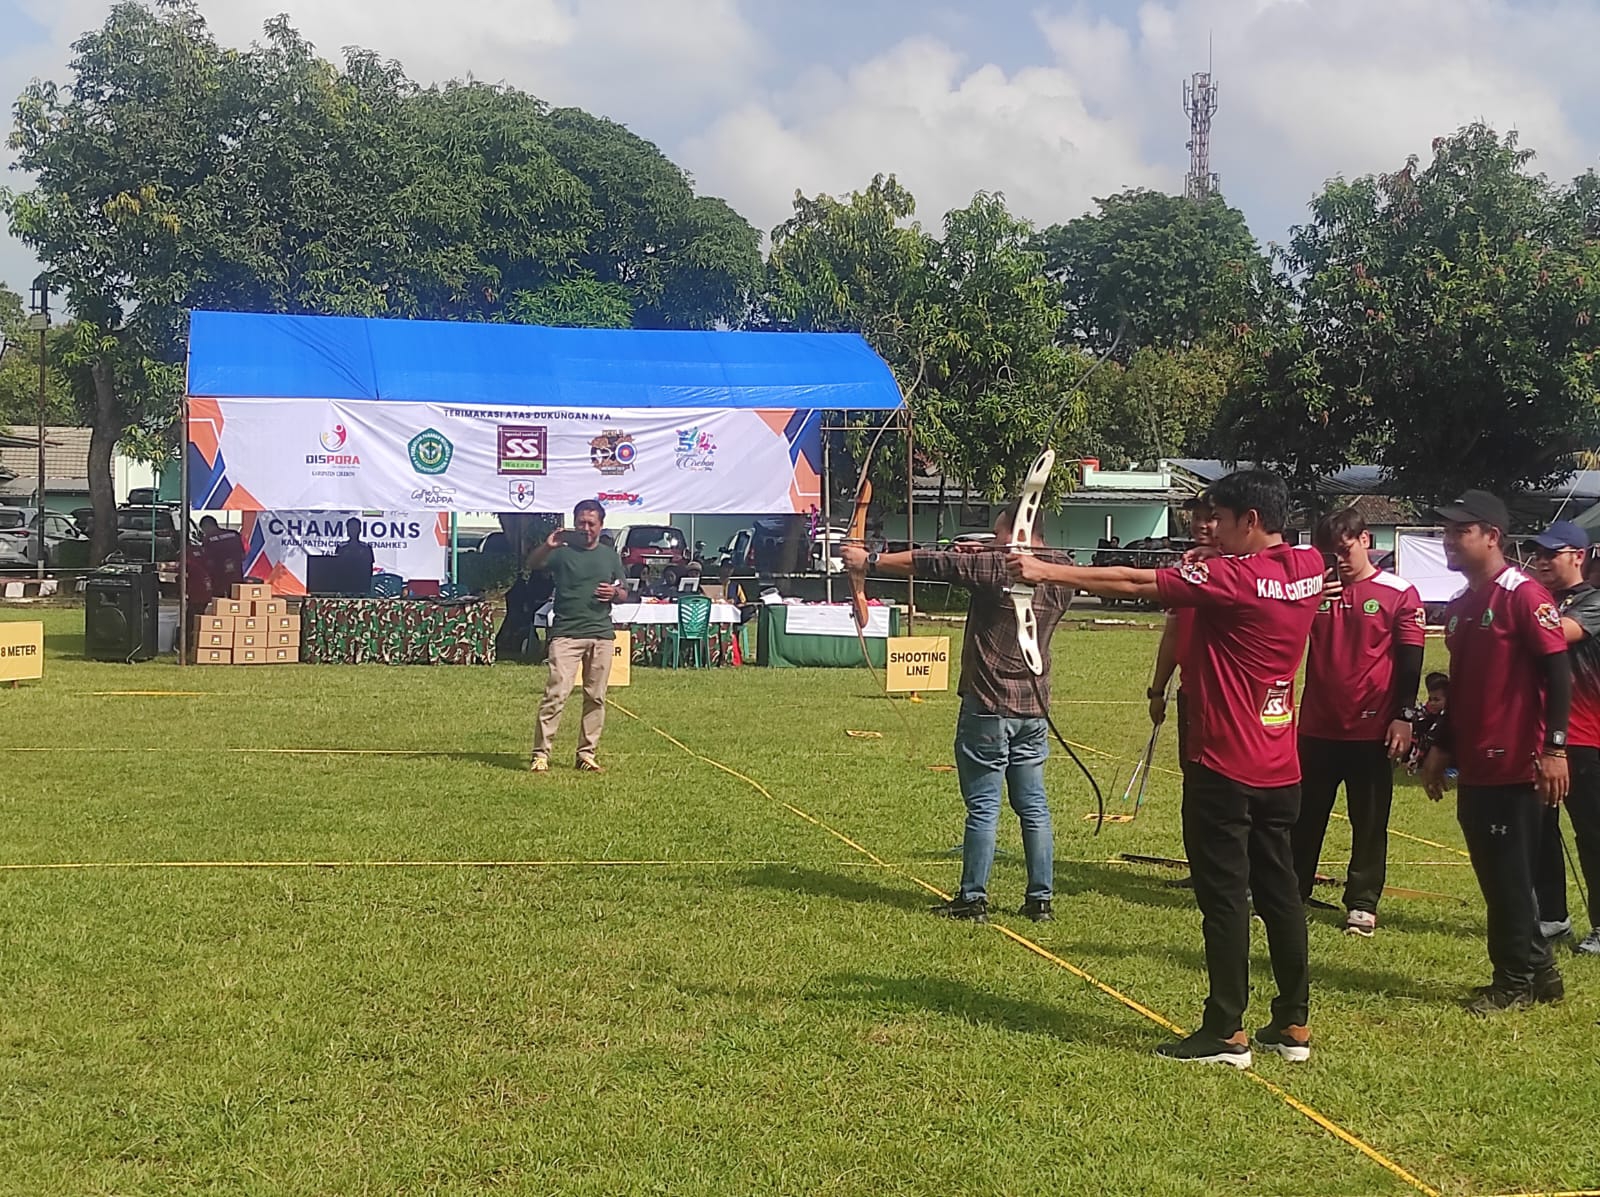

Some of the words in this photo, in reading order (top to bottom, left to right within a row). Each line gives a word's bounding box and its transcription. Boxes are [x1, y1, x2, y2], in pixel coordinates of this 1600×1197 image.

[443, 408, 502, 418] TERIMAKASI
[505, 411, 530, 419] ATAS
[533, 411, 588, 420] DUKUNGAN
[591, 412, 611, 420] NYA
[506, 438, 539, 458] SS
[306, 454, 360, 464] DISPORA
[425, 496, 454, 504] KAPPA
[268, 519, 421, 539] CHAMIONS
[1257, 578, 1287, 600] KAB.
[8, 645, 36, 657] METER
[890, 652, 946, 663] SHOOTING
[906, 666, 929, 675] LINE
